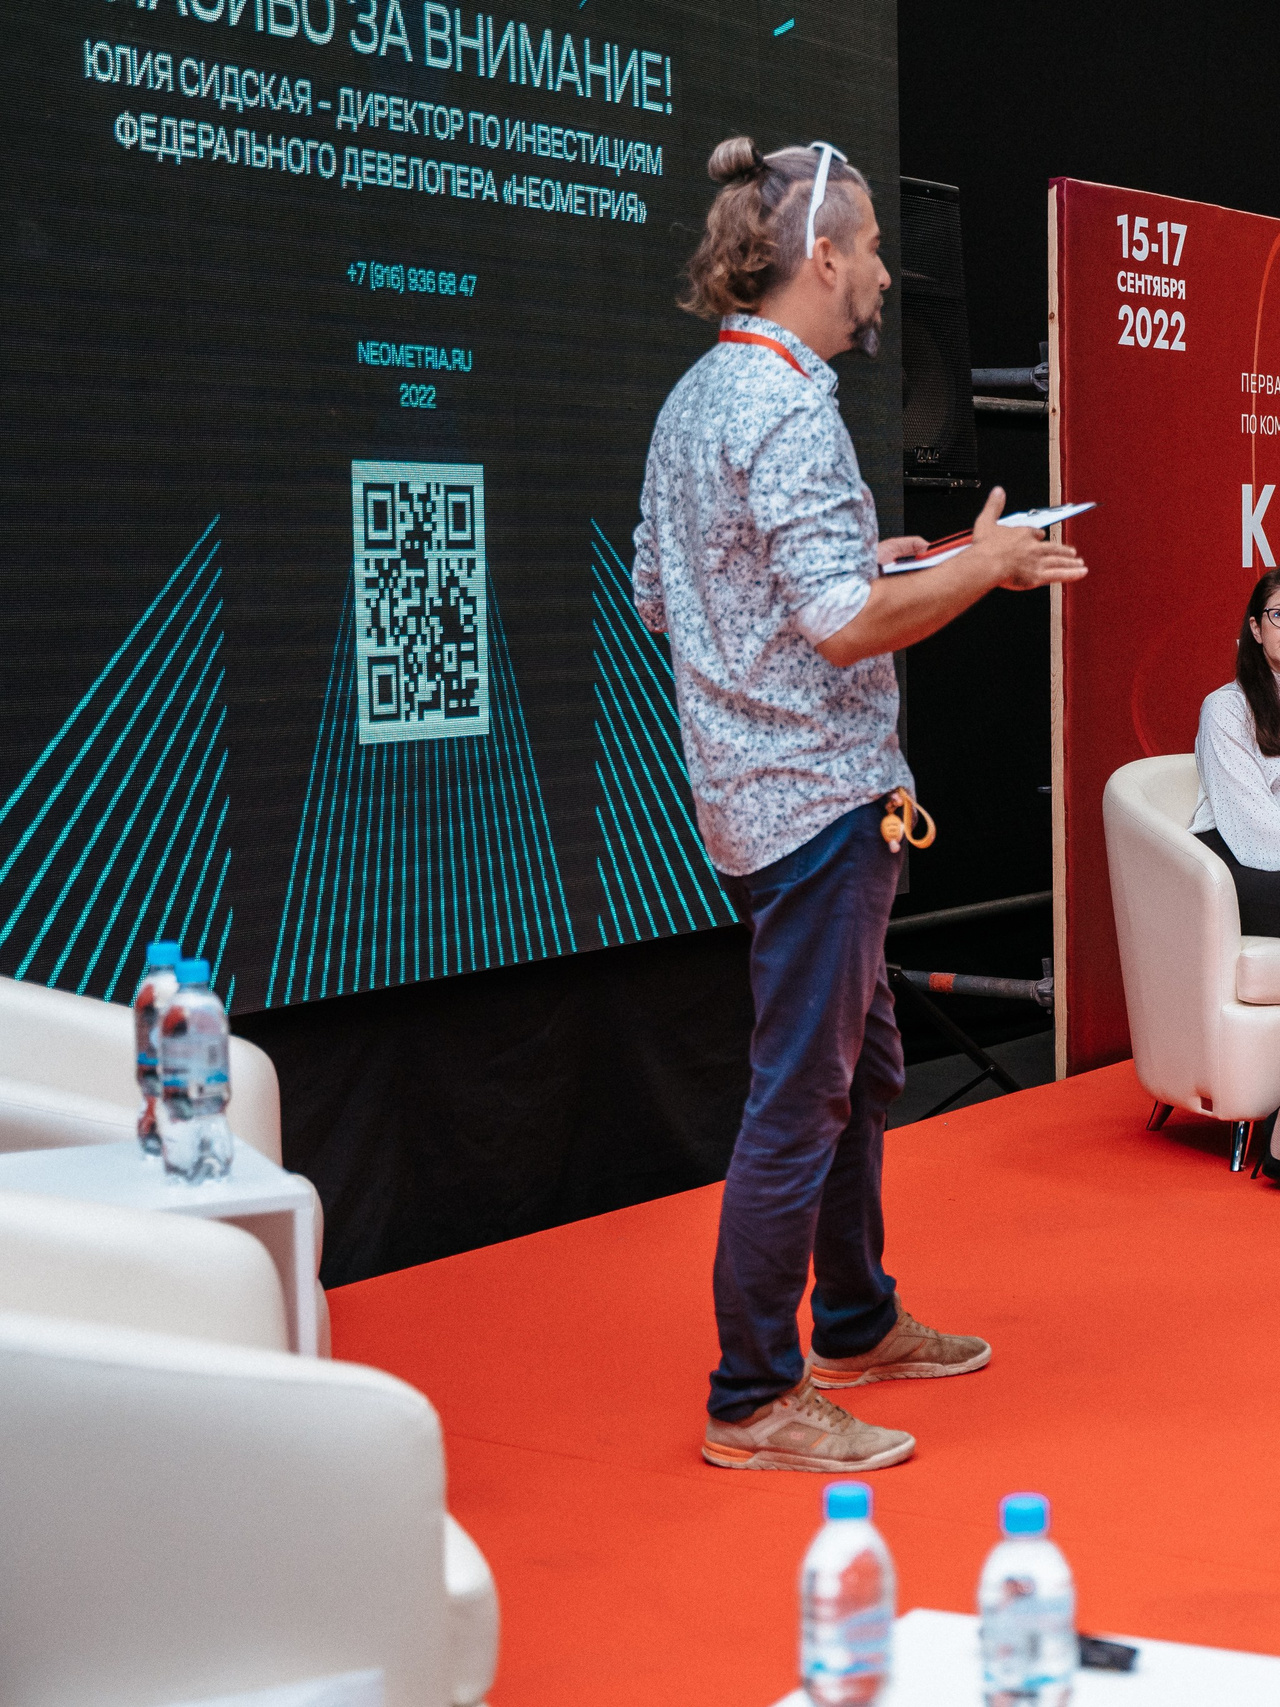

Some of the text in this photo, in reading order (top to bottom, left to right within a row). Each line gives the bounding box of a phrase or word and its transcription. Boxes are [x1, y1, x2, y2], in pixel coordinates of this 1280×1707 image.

[350, 0, 413, 62] ЗА
[424, 2, 673, 115] ВНИМАНИЕ!
[83, 38, 174, 93] ЮЛИЯ
[179, 57, 312, 116] СИДСКАЯ
[336, 86, 464, 141] ДИРЕКТОР
[468, 110, 501, 149] ПО
[504, 117, 664, 177] ИНВЕСТИЦИЯМ
[114, 110, 648, 224] ФЕДЕРАЛЬНОГО ДЕВЕЛОПЕРА «НЕОМЕТРИЯ»
[1117, 213, 1188, 267] 15-17
[346, 260, 367, 285] +7
[369, 260, 405, 294] (916)
[459, 273, 477, 297] 47
[1117, 270, 1186, 301] СЕНТЯБРЯ
[1117, 304, 1187, 352] 2022
[357, 340, 472, 372] NEOMETRIA.RU
[399, 382, 437, 409] 2022
[1241, 413, 1257, 435] ПО
